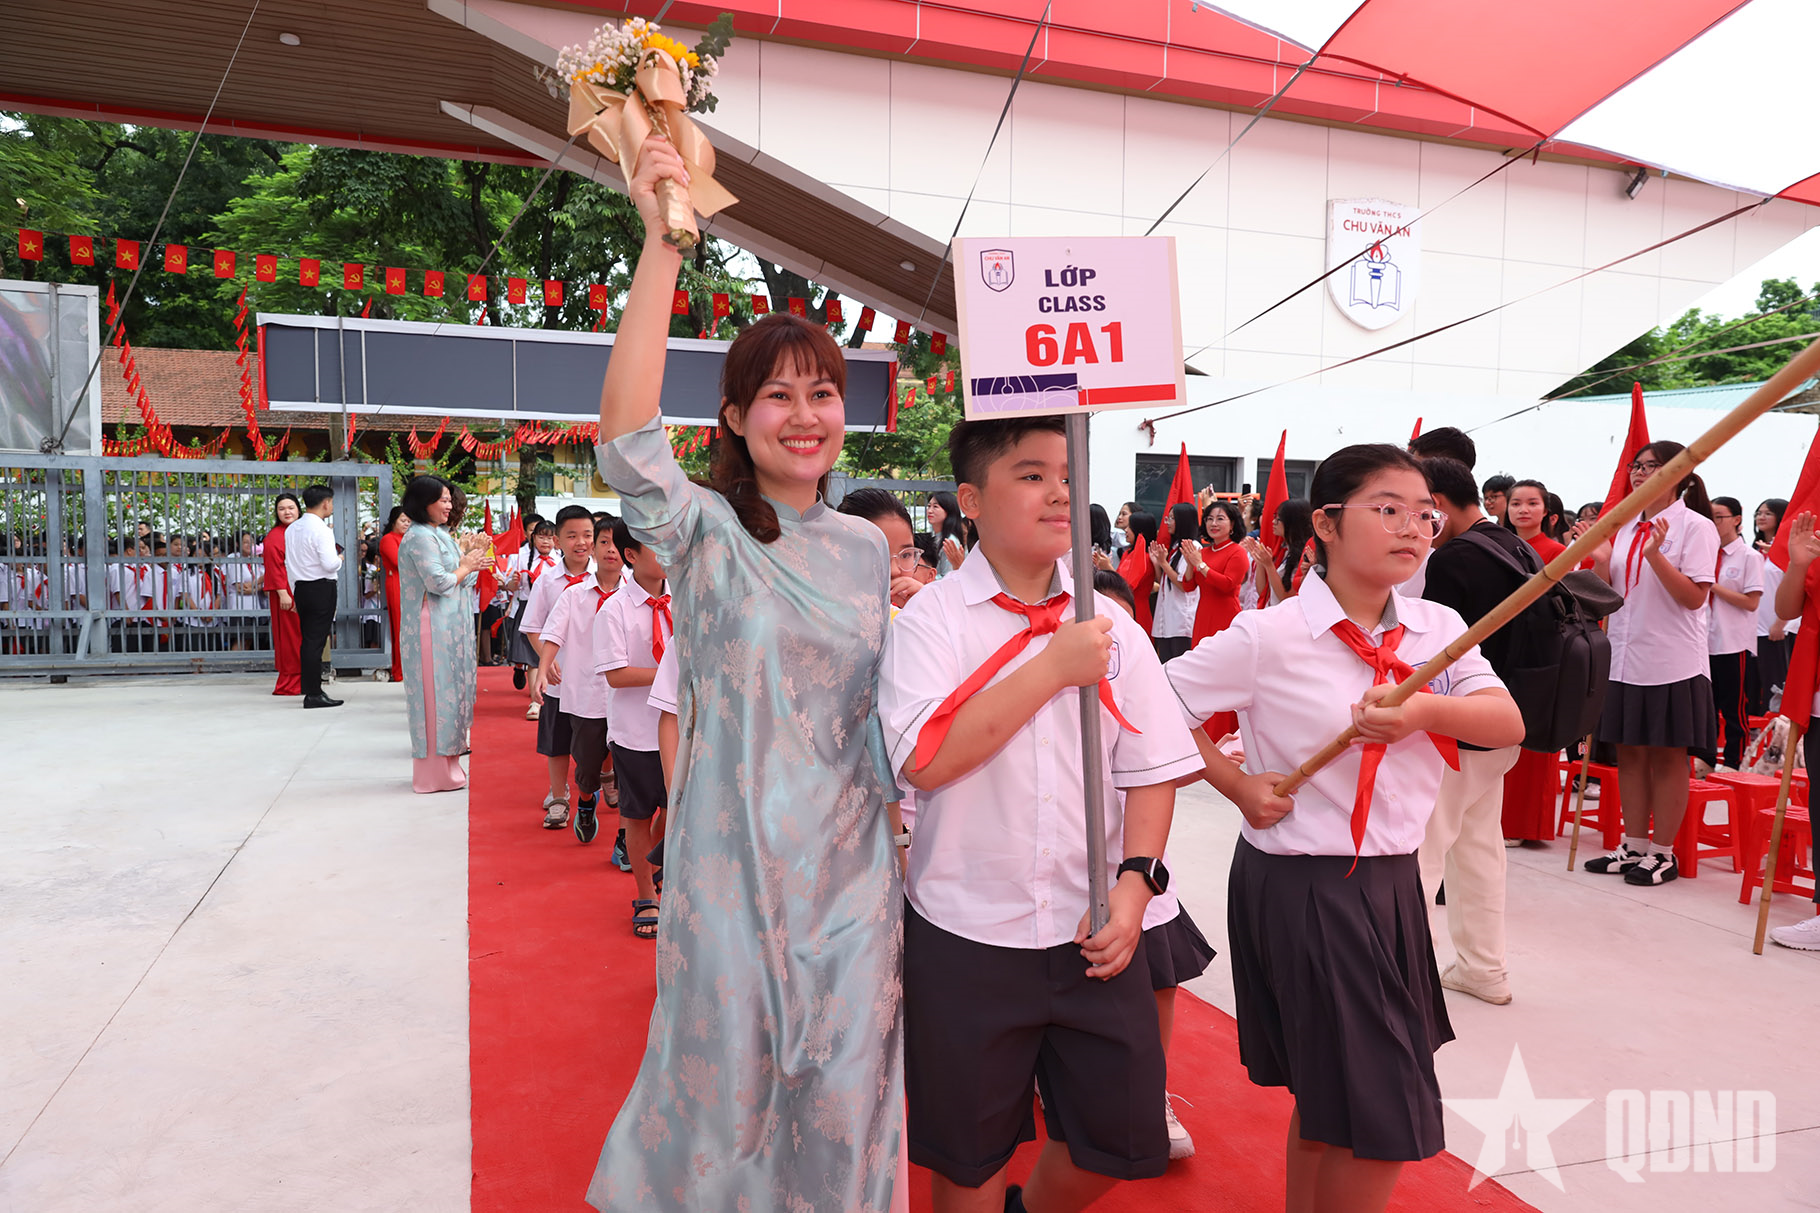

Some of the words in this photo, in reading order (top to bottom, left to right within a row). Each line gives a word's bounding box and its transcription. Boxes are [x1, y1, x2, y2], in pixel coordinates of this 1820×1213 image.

[1383, 211, 1401, 219] THCS
[1343, 219, 1367, 232] CHU
[1369, 221, 1392, 235] VĂN
[1394, 226, 1410, 237] AN
[1044, 265, 1096, 287] LỚP
[1038, 295, 1106, 313] CLASS
[1025, 321, 1124, 367] 6A1
